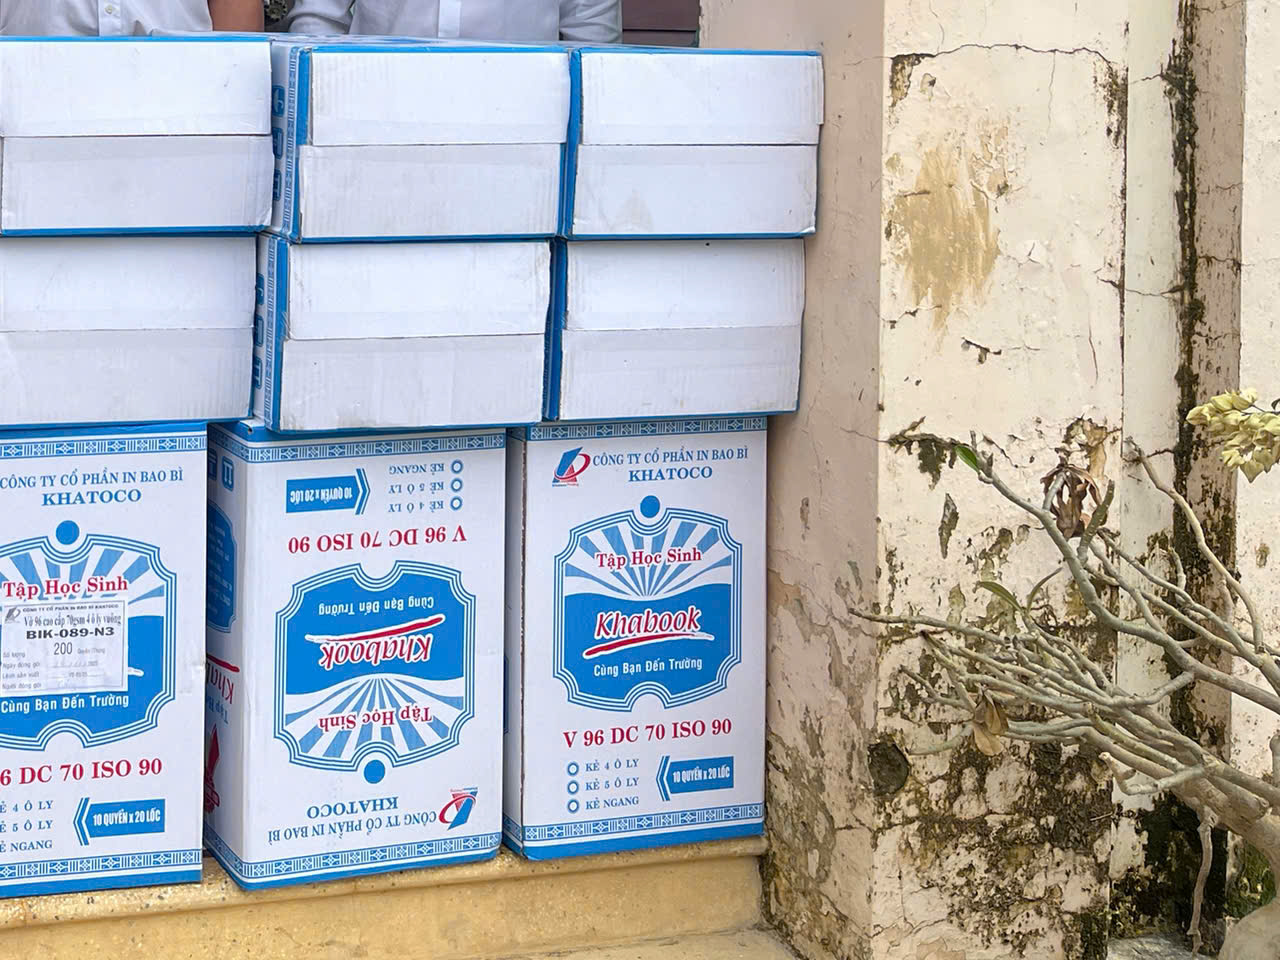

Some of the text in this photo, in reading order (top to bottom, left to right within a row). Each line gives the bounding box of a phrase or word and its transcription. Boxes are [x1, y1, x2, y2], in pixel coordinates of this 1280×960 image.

[593, 445, 748, 466] CÔNG TY CỔ PHẦN IN BAO BÌ
[0, 467, 183, 489] CÔNG TY CỔ PHẦN IN BAO BÌ
[629, 466, 712, 482] KHATOCO
[41, 489, 141, 506] KHATOCO
[288, 525, 467, 553] V 96 DC 70 ISO 90
[596, 548, 701, 570] Tập Học Sinh
[3, 576, 128, 600] Tập Học Sinh
[319, 596, 434, 614] Cùng Bạn Đến Trường
[596, 606, 701, 637] Khabook
[26, 627, 114, 640] BIK-089-N3
[54, 642, 73, 655] 200
[320, 634, 432, 668] Khabook
[594, 658, 702, 676] Cùng Bạn Đến Trường
[1, 694, 129, 714] Cùng Bạn Đến Trường
[320, 706, 432, 730] Tập Học Sinh
[563, 719, 731, 747] V 96 DC 70 ISO 90
[20, 766, 52, 784] DC
[60, 764, 84, 781] 70
[92, 760, 131, 779] ISO
[139, 758, 162, 776] 90
[12, 803, 18, 812] 4
[24, 800, 32, 811] Ô
[39, 800, 53, 810] LY
[93, 814, 102, 825] 10
[103, 808, 128, 824] QUYỂN
[134, 812, 145, 822] 20
[146, 809, 160, 822] LỐC
[307, 796, 398, 818] KHATOCO
[268, 812, 436, 844] CÔNG TY CỔ PHẦN IN BAO BÌ
[10, 840, 52, 852] NGANG
